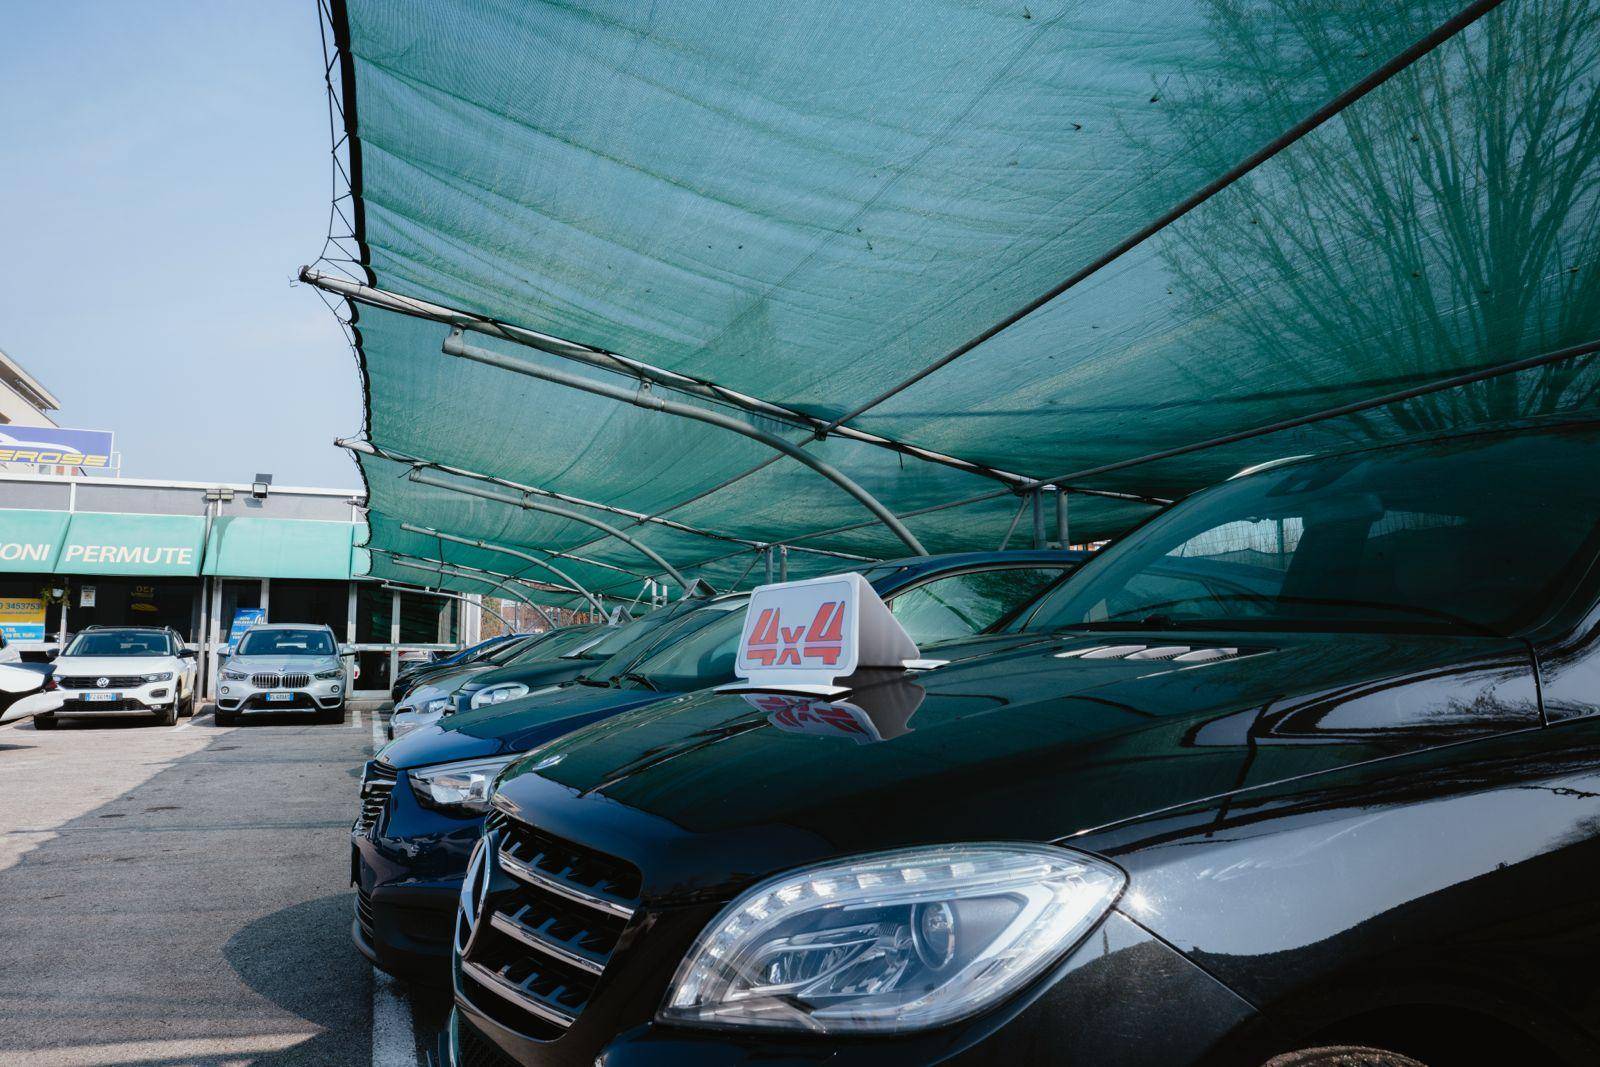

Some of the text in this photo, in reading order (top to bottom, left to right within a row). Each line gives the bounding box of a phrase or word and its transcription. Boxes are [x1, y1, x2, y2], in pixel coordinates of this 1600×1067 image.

[0, 543, 51, 561] ONI
[65, 544, 193, 565] PERMUTE
[746, 600, 845, 665] 4x4
